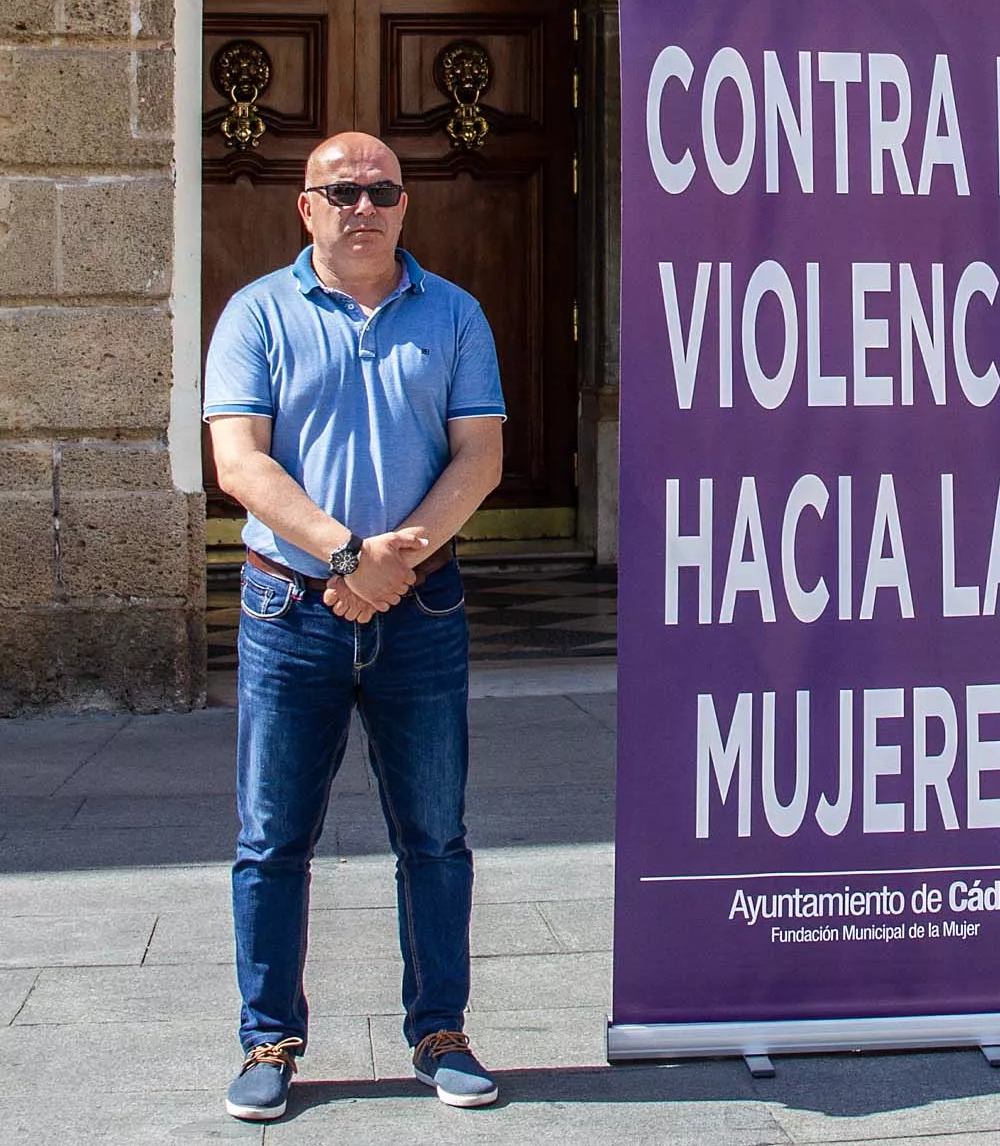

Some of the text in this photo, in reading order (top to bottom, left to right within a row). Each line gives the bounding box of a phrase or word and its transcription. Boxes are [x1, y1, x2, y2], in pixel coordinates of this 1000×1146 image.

[646, 45, 971, 195] CONTRA
[664, 474, 915, 625] HACIA
[728, 886, 904, 925] Ayuntamiento
[911, 883, 942, 914] de
[771, 920, 981, 942] Fundación Municipal de la Mujer
